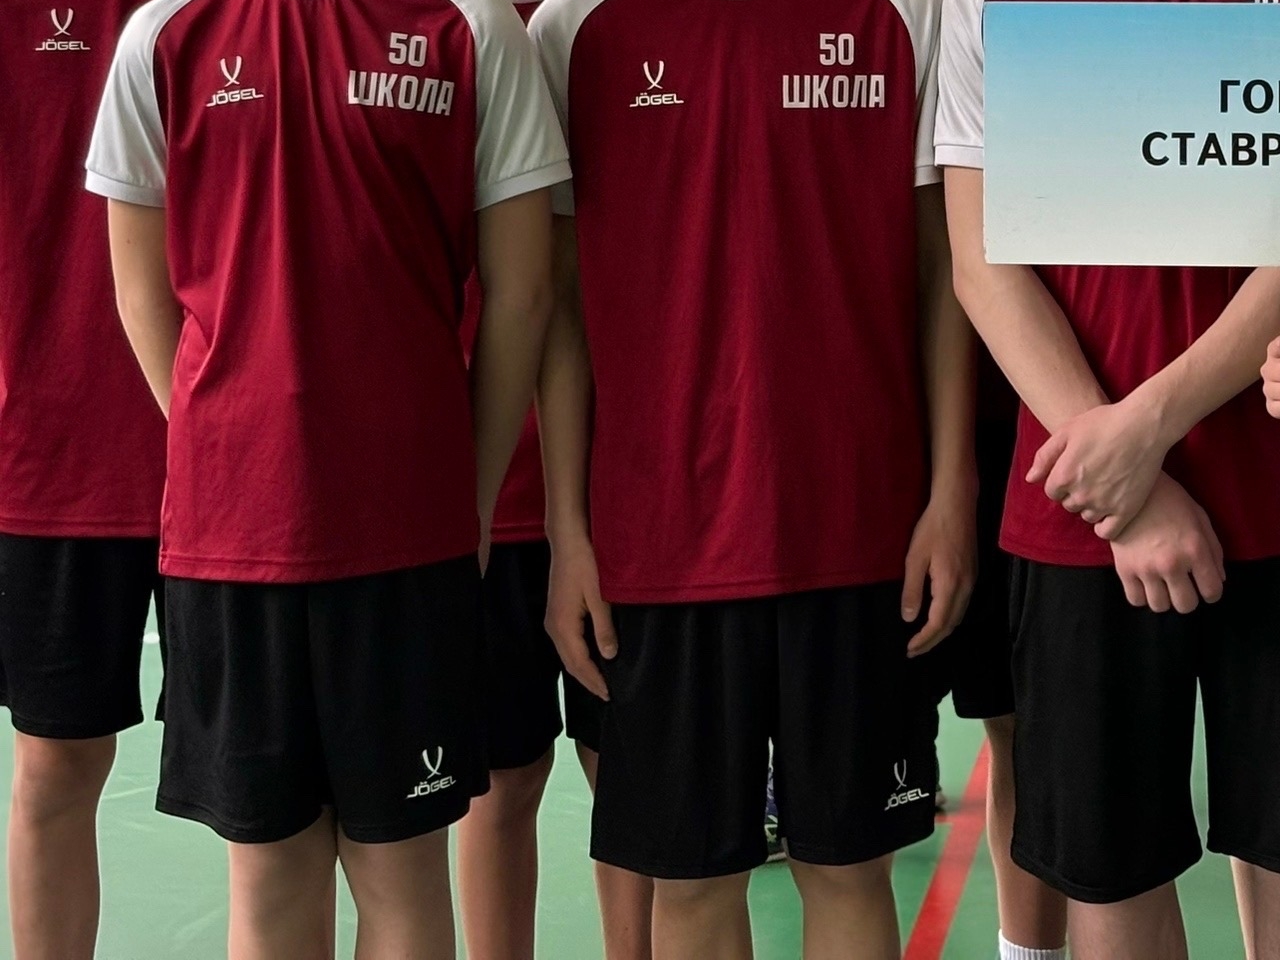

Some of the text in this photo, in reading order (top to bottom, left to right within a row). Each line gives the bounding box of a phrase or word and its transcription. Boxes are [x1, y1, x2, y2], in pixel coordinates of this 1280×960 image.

[35, 39, 91, 52] JÖGEL
[388, 32, 427, 67] 50
[819, 33, 855, 66] 50
[205, 88, 265, 108] JÖGEL
[347, 70, 455, 116] ШКОЛА
[629, 92, 685, 108] JÖGEL
[782, 74, 885, 109] ШКОЛА
[405, 775, 457, 800] JÖGEL
